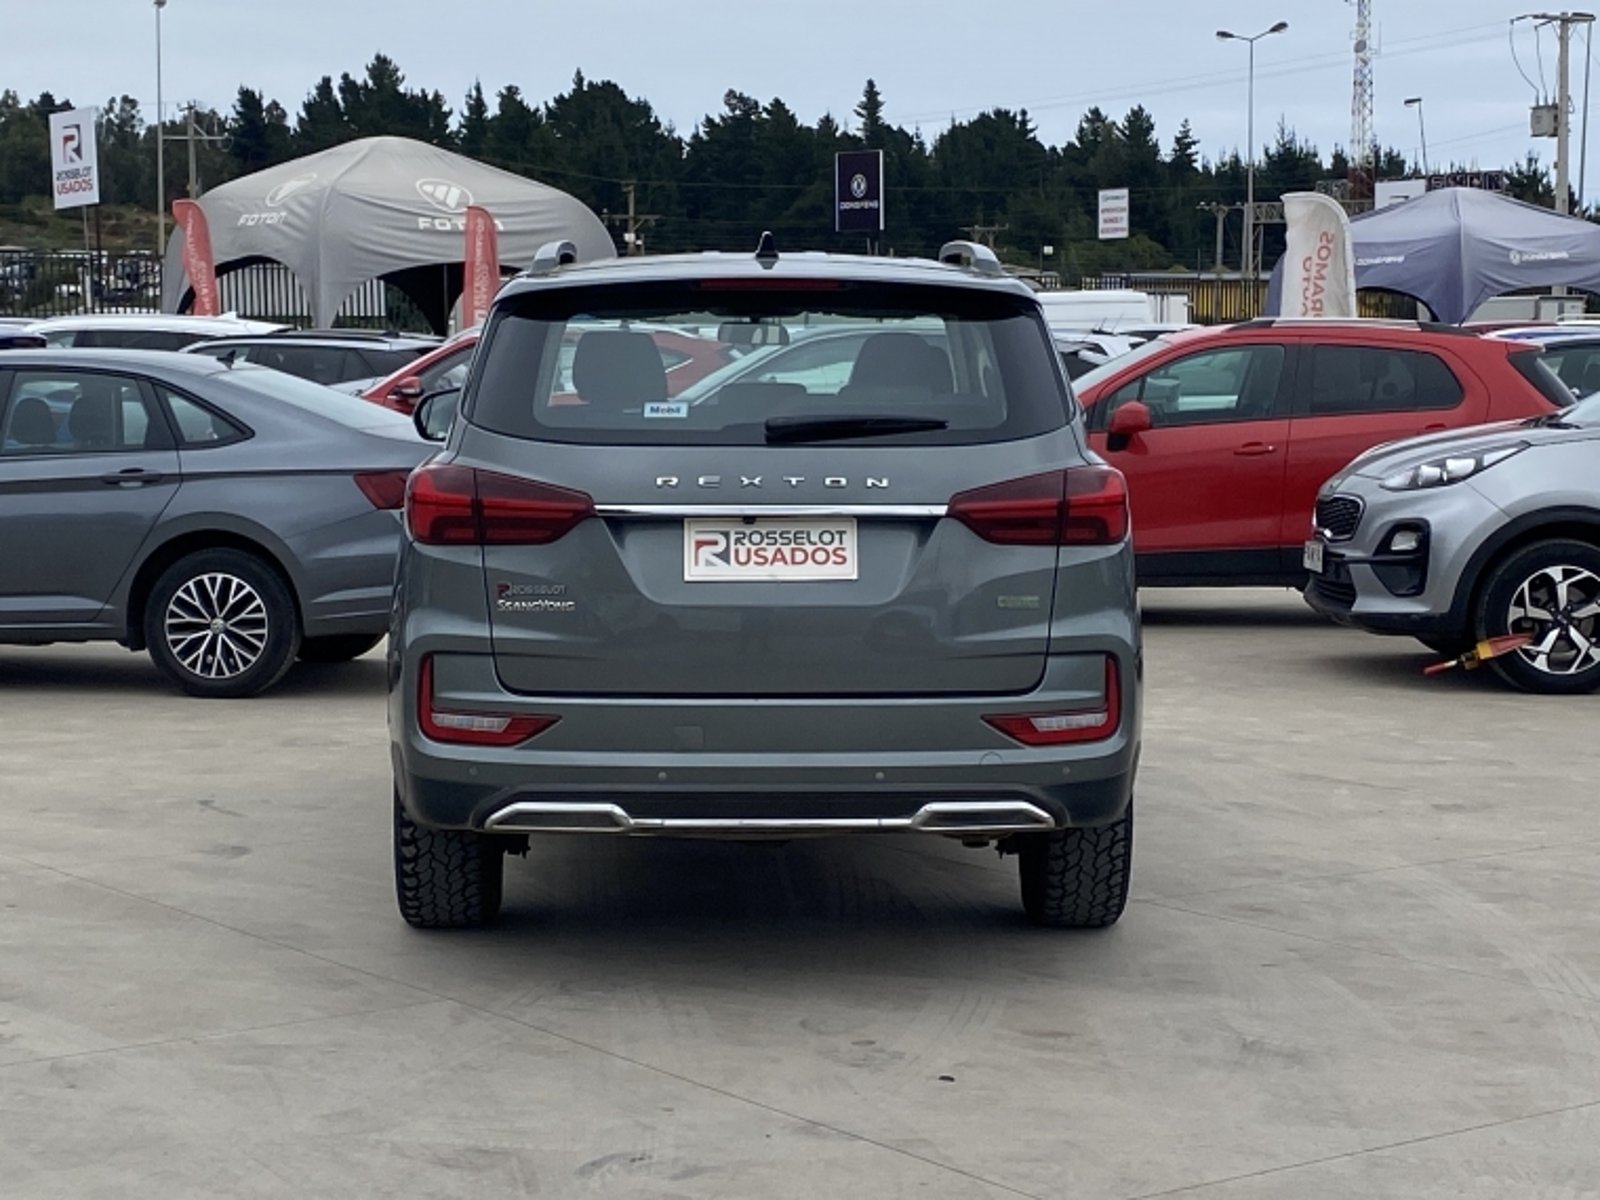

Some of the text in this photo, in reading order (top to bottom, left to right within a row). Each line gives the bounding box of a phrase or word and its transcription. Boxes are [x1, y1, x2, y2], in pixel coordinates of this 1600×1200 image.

[56, 179, 93, 196] USADOS
[650, 405, 681, 415] Mobil
[655, 475, 889, 488] REXTON
[733, 530, 848, 546] ROSSELOT
[733, 546, 849, 567] USADOS
